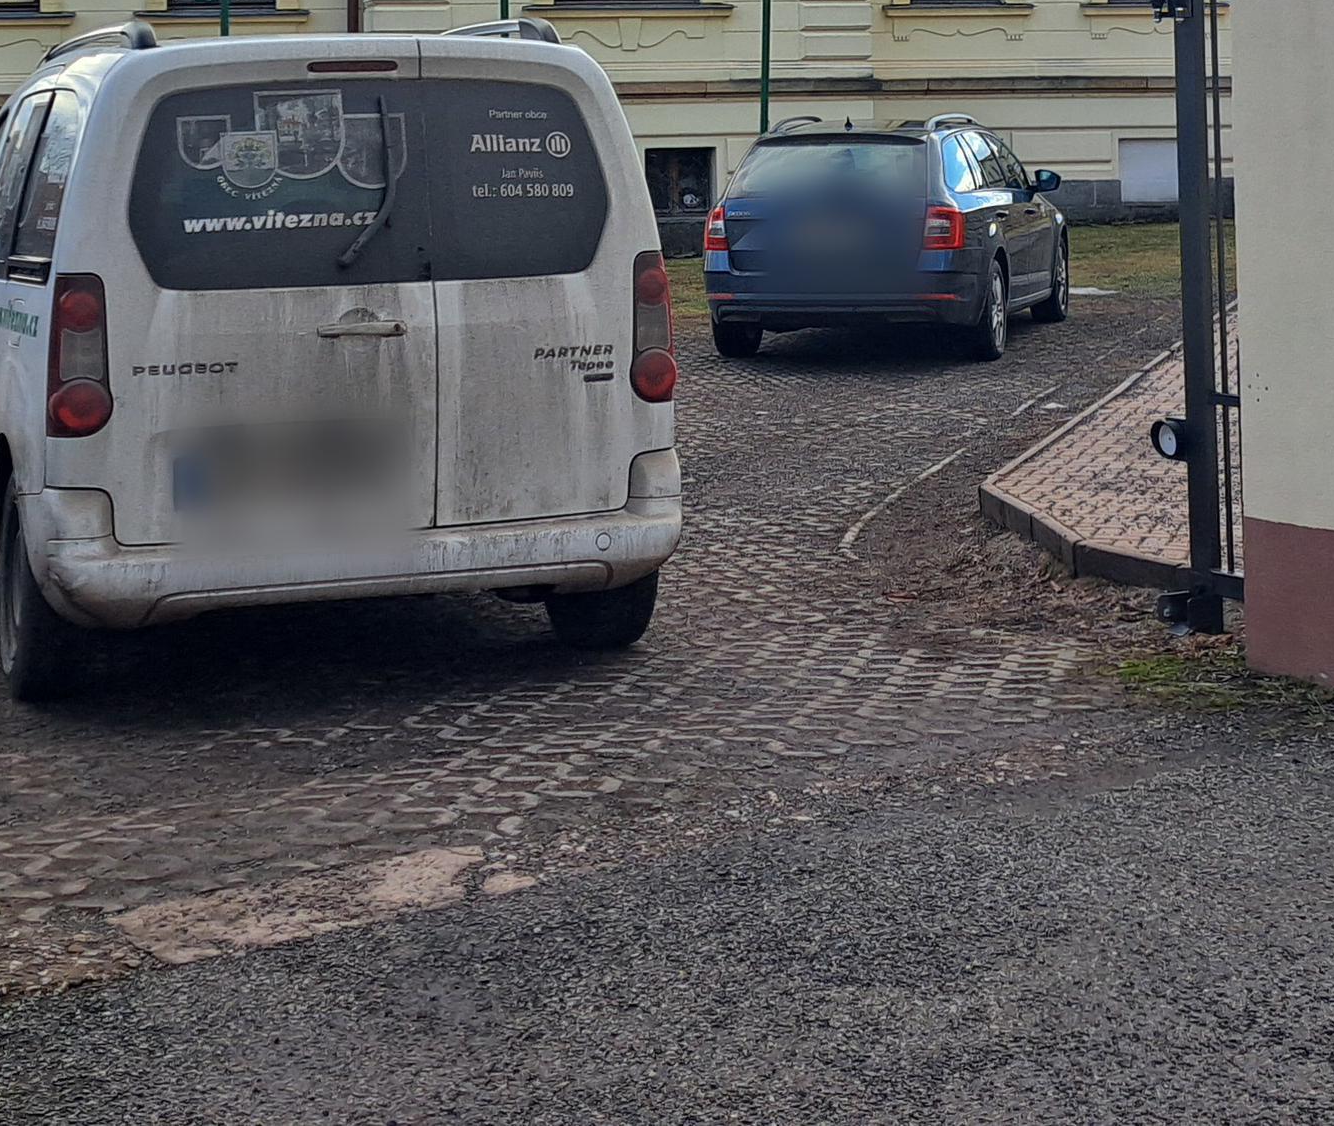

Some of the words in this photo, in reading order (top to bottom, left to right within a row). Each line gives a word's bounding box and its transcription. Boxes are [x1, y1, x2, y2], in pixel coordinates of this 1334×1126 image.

[488, 109, 523, 119] Partner
[470, 134, 542, 152] Allianz
[472, 184, 497, 197] tel.:
[500, 184, 523, 197] 604
[526, 184, 549, 196] 580
[551, 184, 574, 196] 809
[183, 209, 378, 234] www.vitezna.cz
[533, 344, 614, 360] PARTNER
[132, 362, 238, 376] PEUGEOT
[570, 360, 614, 372] Tepee
